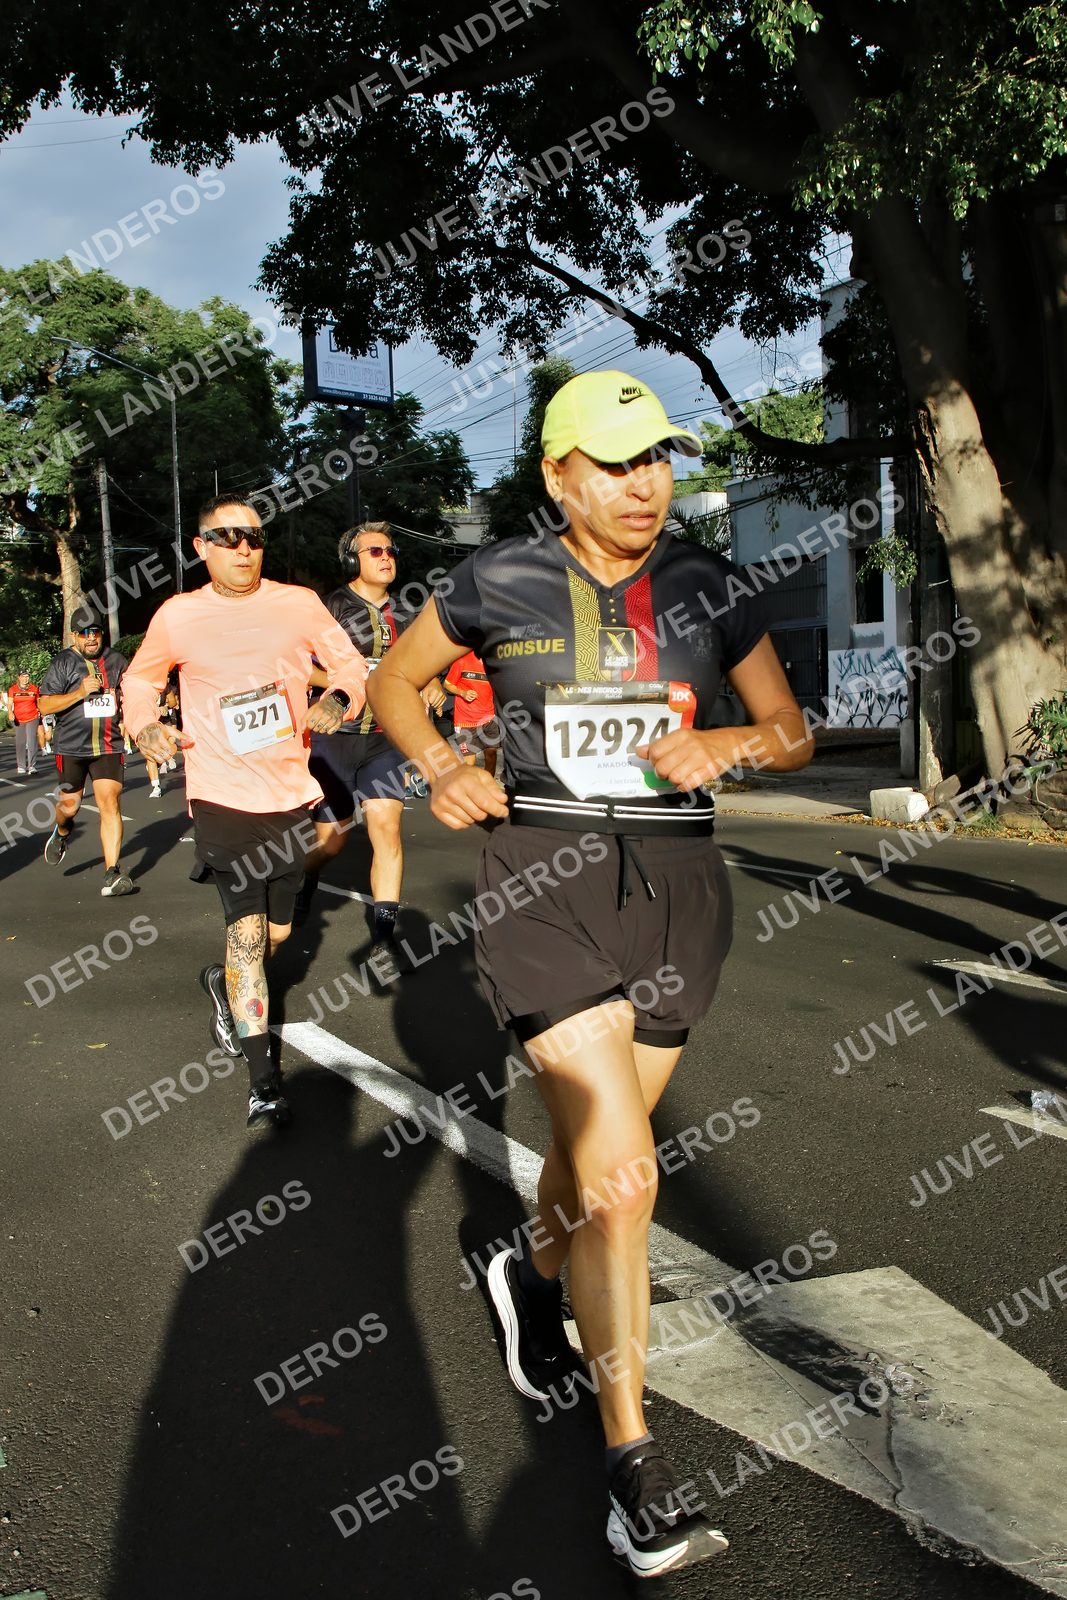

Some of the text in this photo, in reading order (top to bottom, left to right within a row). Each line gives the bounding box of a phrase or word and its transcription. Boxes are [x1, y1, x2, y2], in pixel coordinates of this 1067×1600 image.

[496, 638, 566, 659] CONSUE
[88, 697, 111, 707] 9652
[233, 702, 280, 732] 9271
[553, 717, 670, 759] 12924
